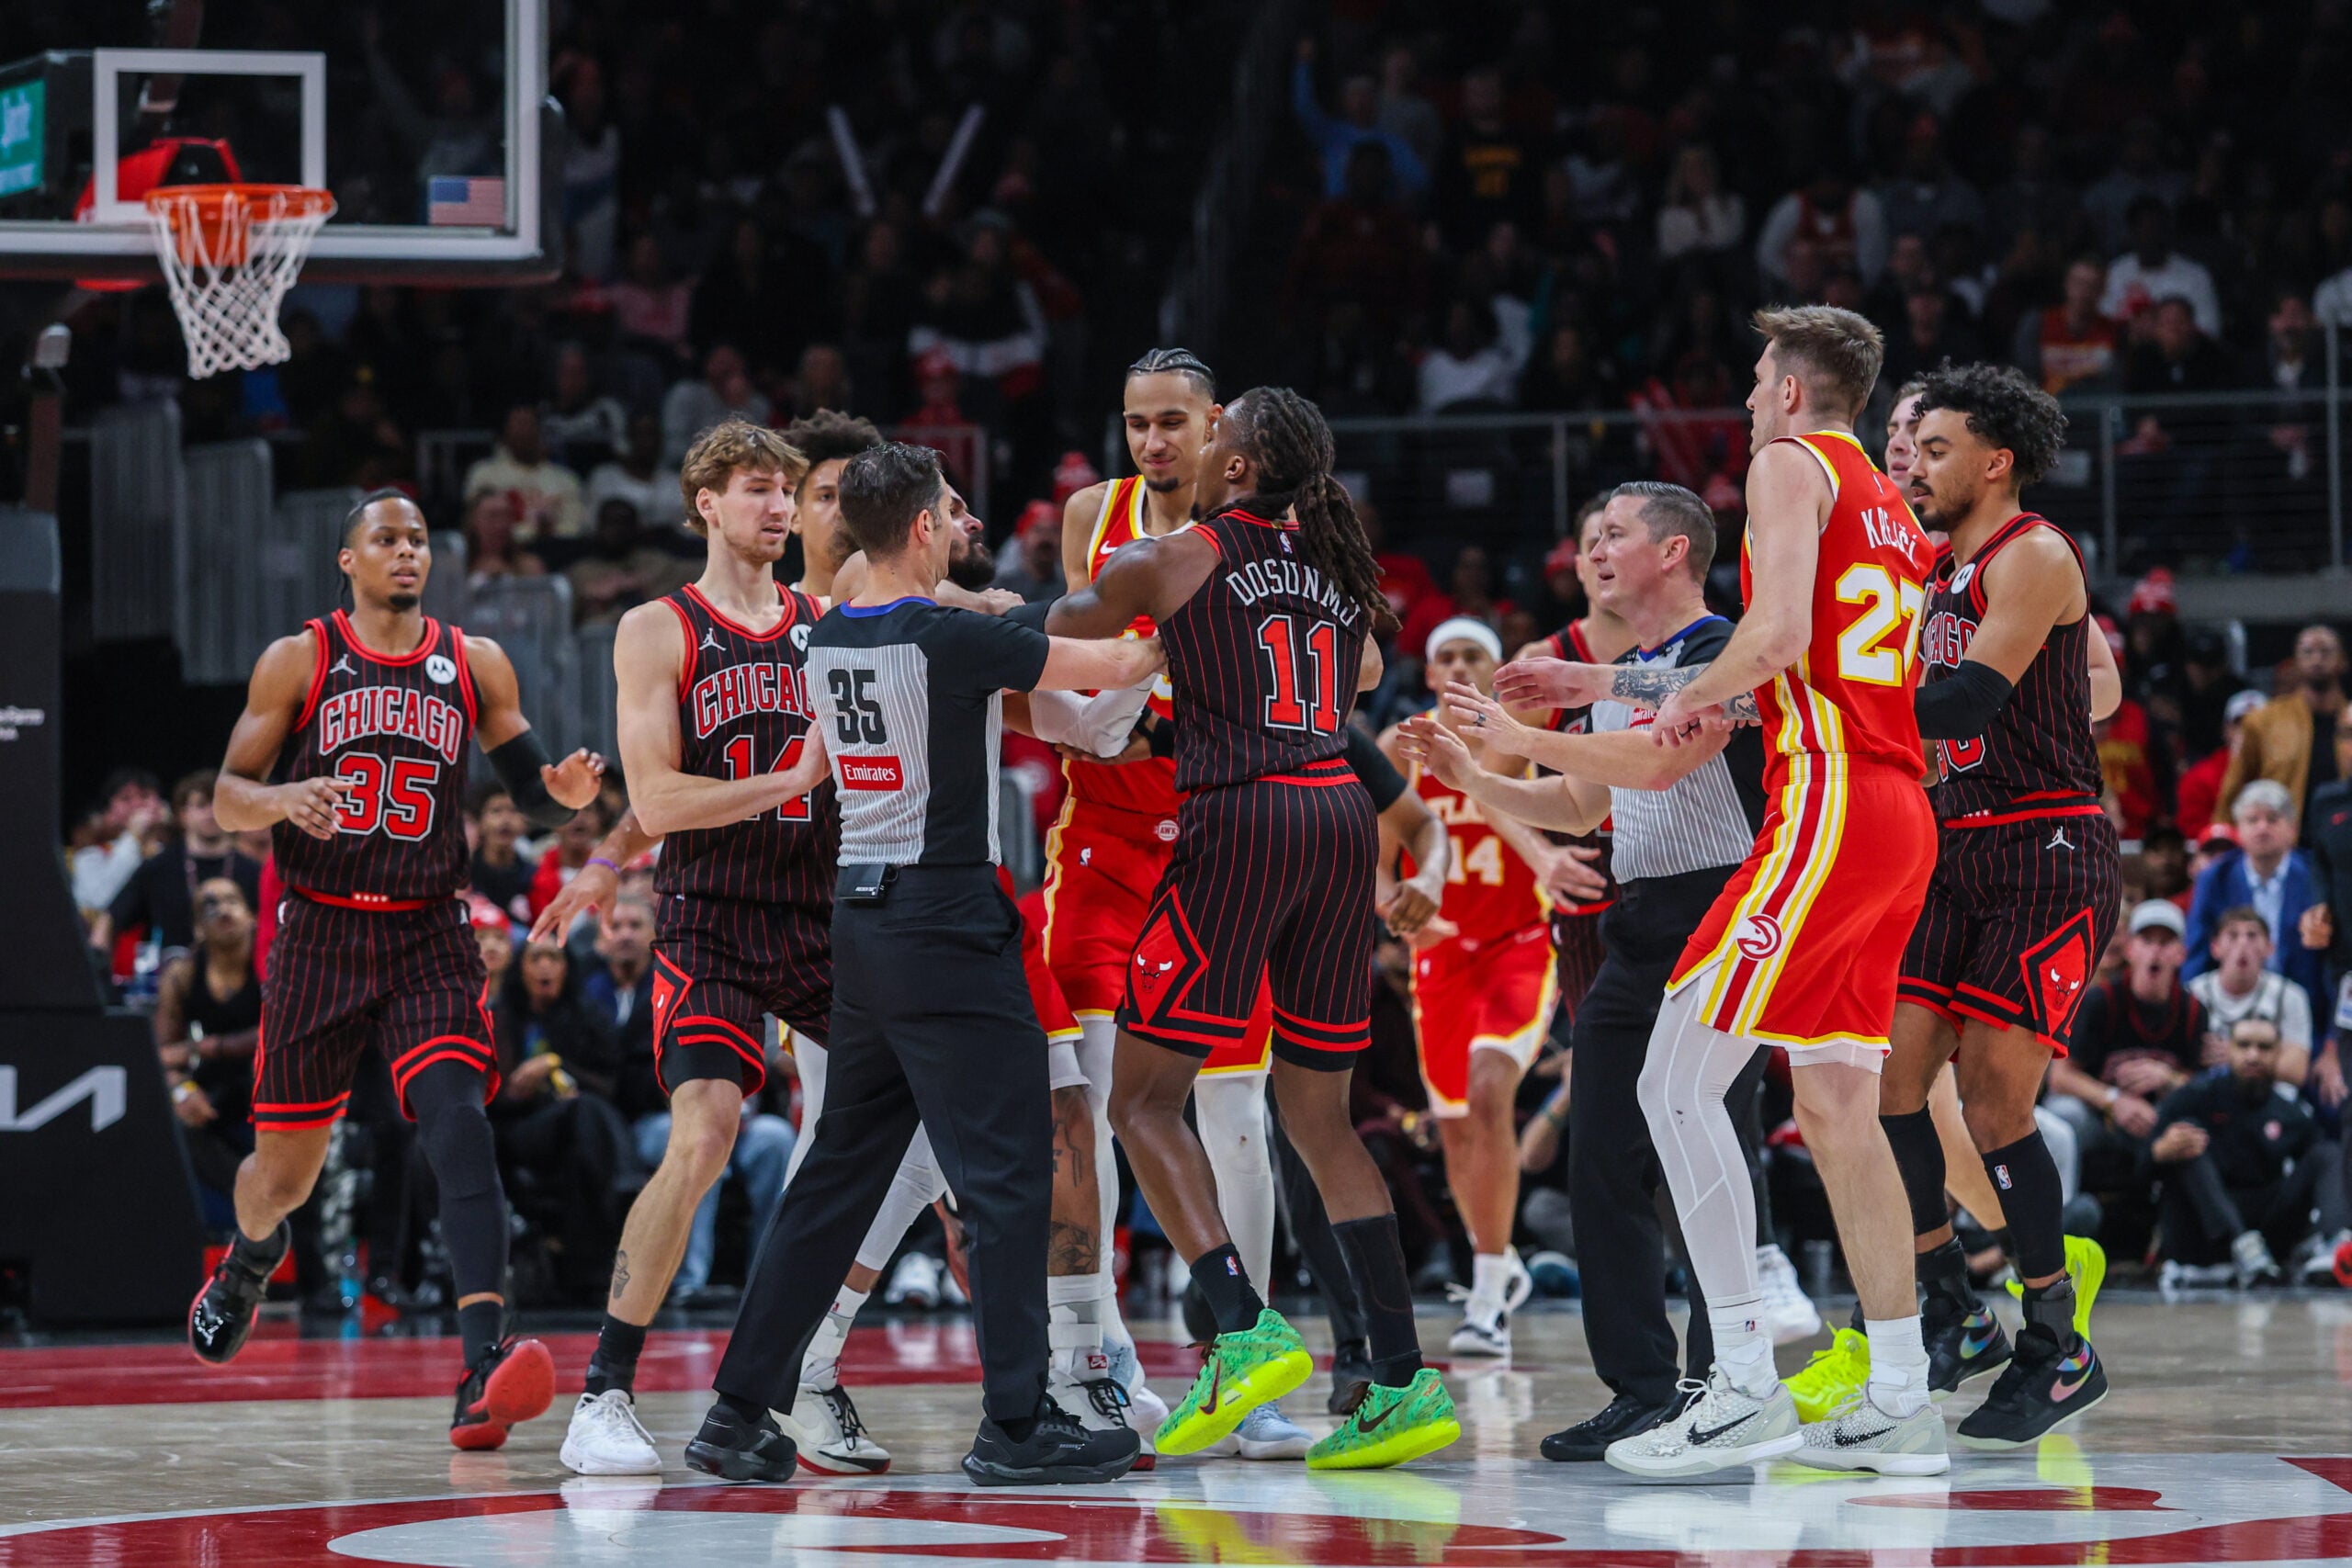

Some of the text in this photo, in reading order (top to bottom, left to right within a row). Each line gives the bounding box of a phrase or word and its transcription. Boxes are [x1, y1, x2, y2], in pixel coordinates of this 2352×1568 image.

[1836, 562, 1925, 688] 27
[827, 668, 888, 745] 35
[1257, 614, 1340, 737] 11
[320, 685, 463, 766] CHICAGO
[332, 751, 441, 842] 35
[843, 763, 897, 782] Emirates
[1447, 834, 1505, 886] 14
